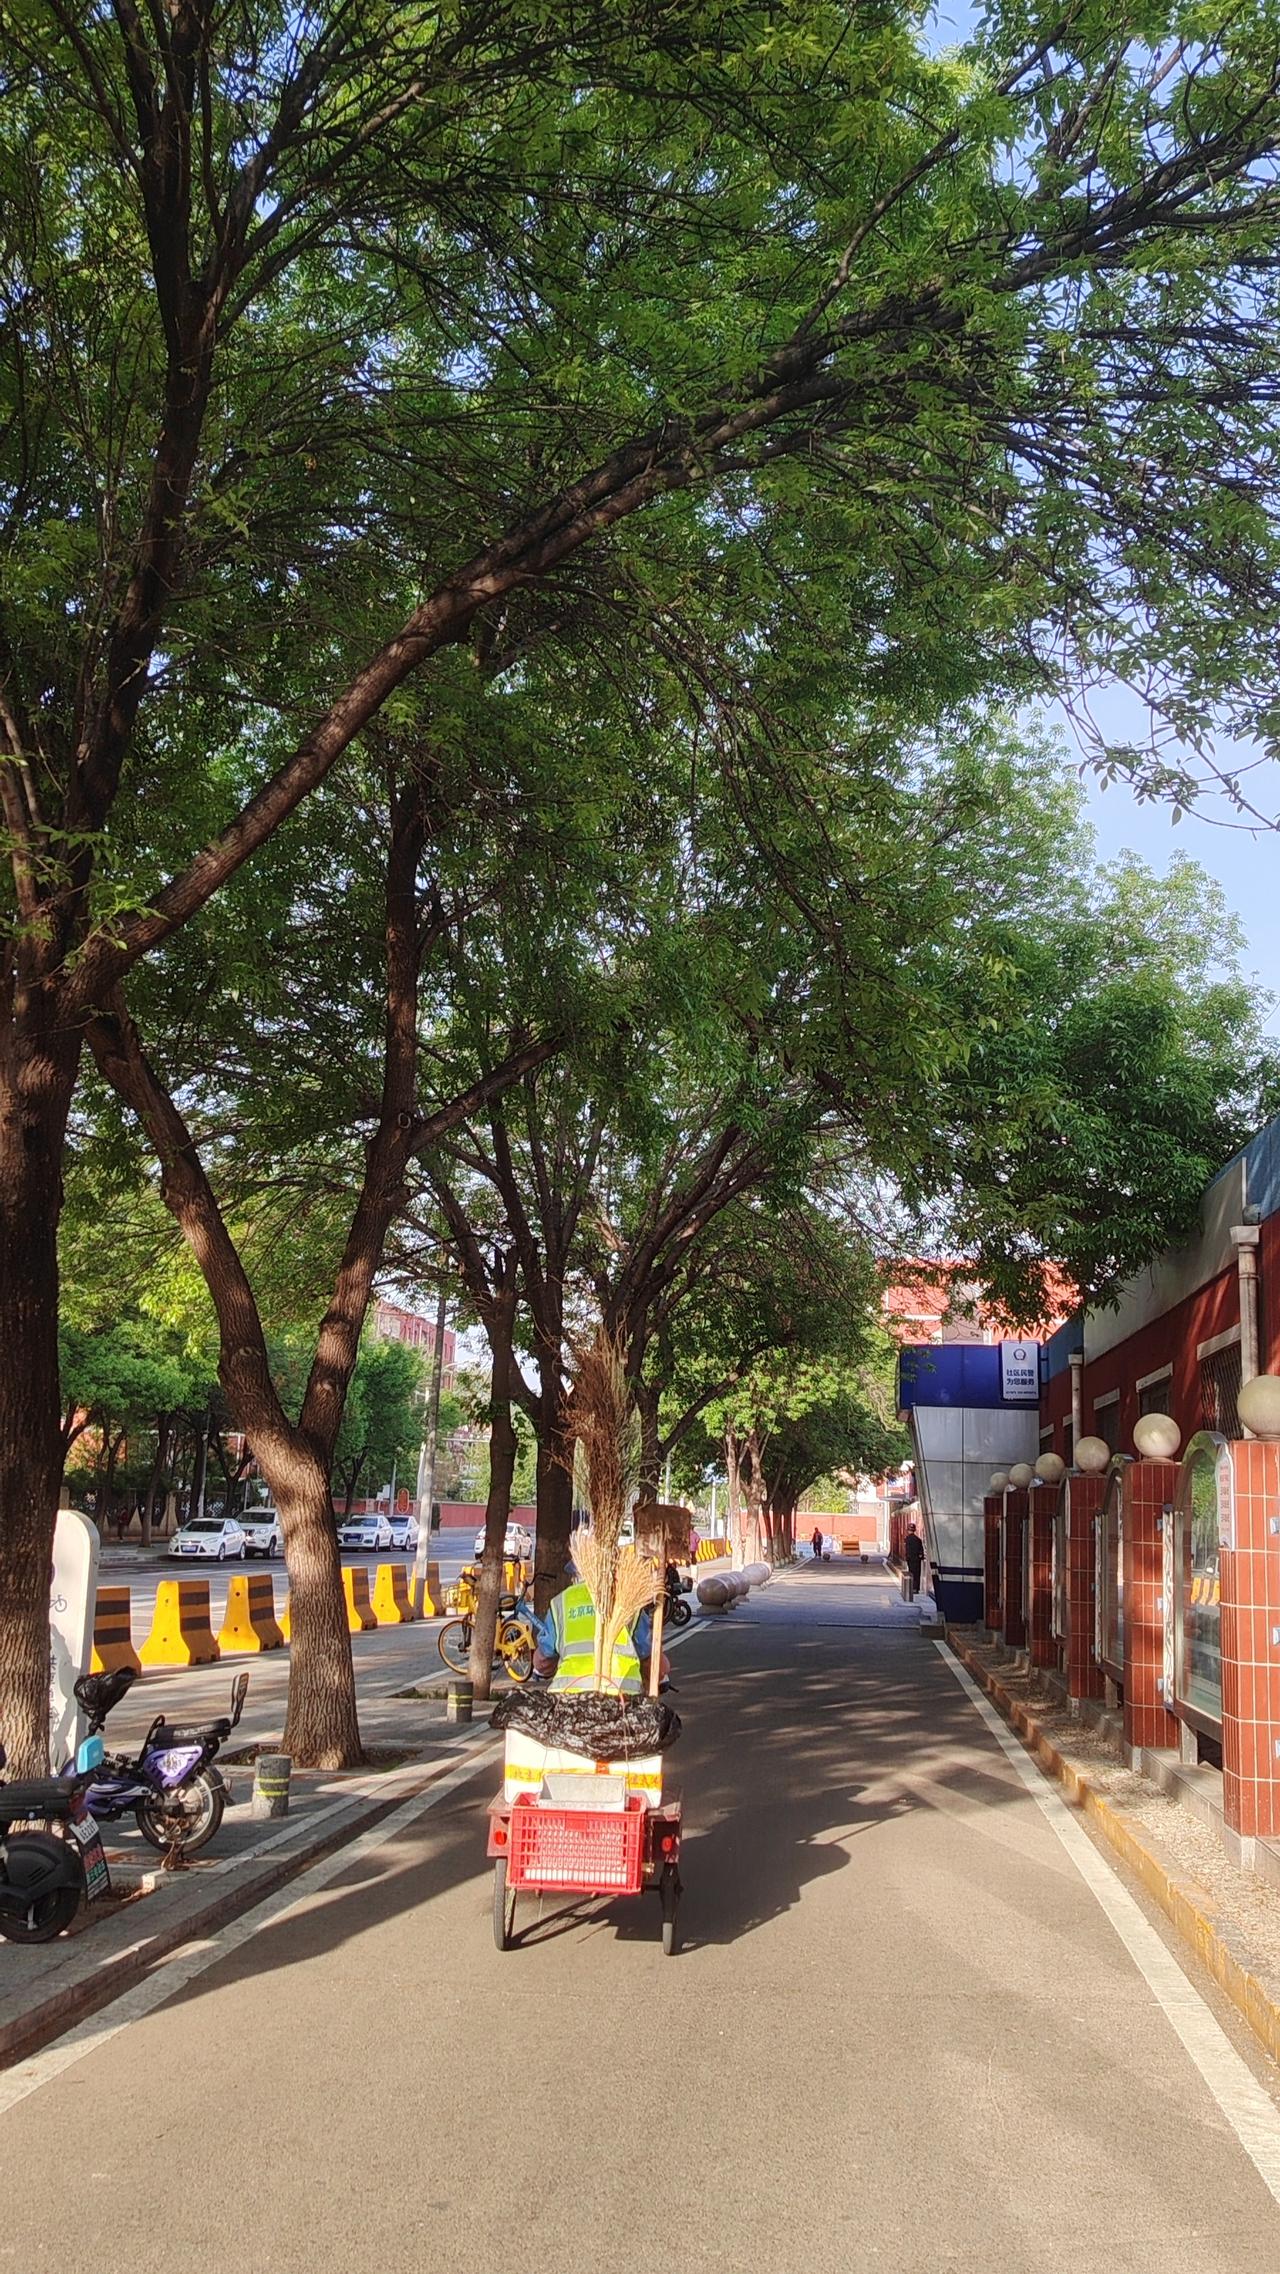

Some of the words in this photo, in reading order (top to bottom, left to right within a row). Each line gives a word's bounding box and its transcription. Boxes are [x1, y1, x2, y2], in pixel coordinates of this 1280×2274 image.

[1006, 1368, 1034, 1377] 社区民警
[1006, 1378, 1035, 1386] 为您服务
